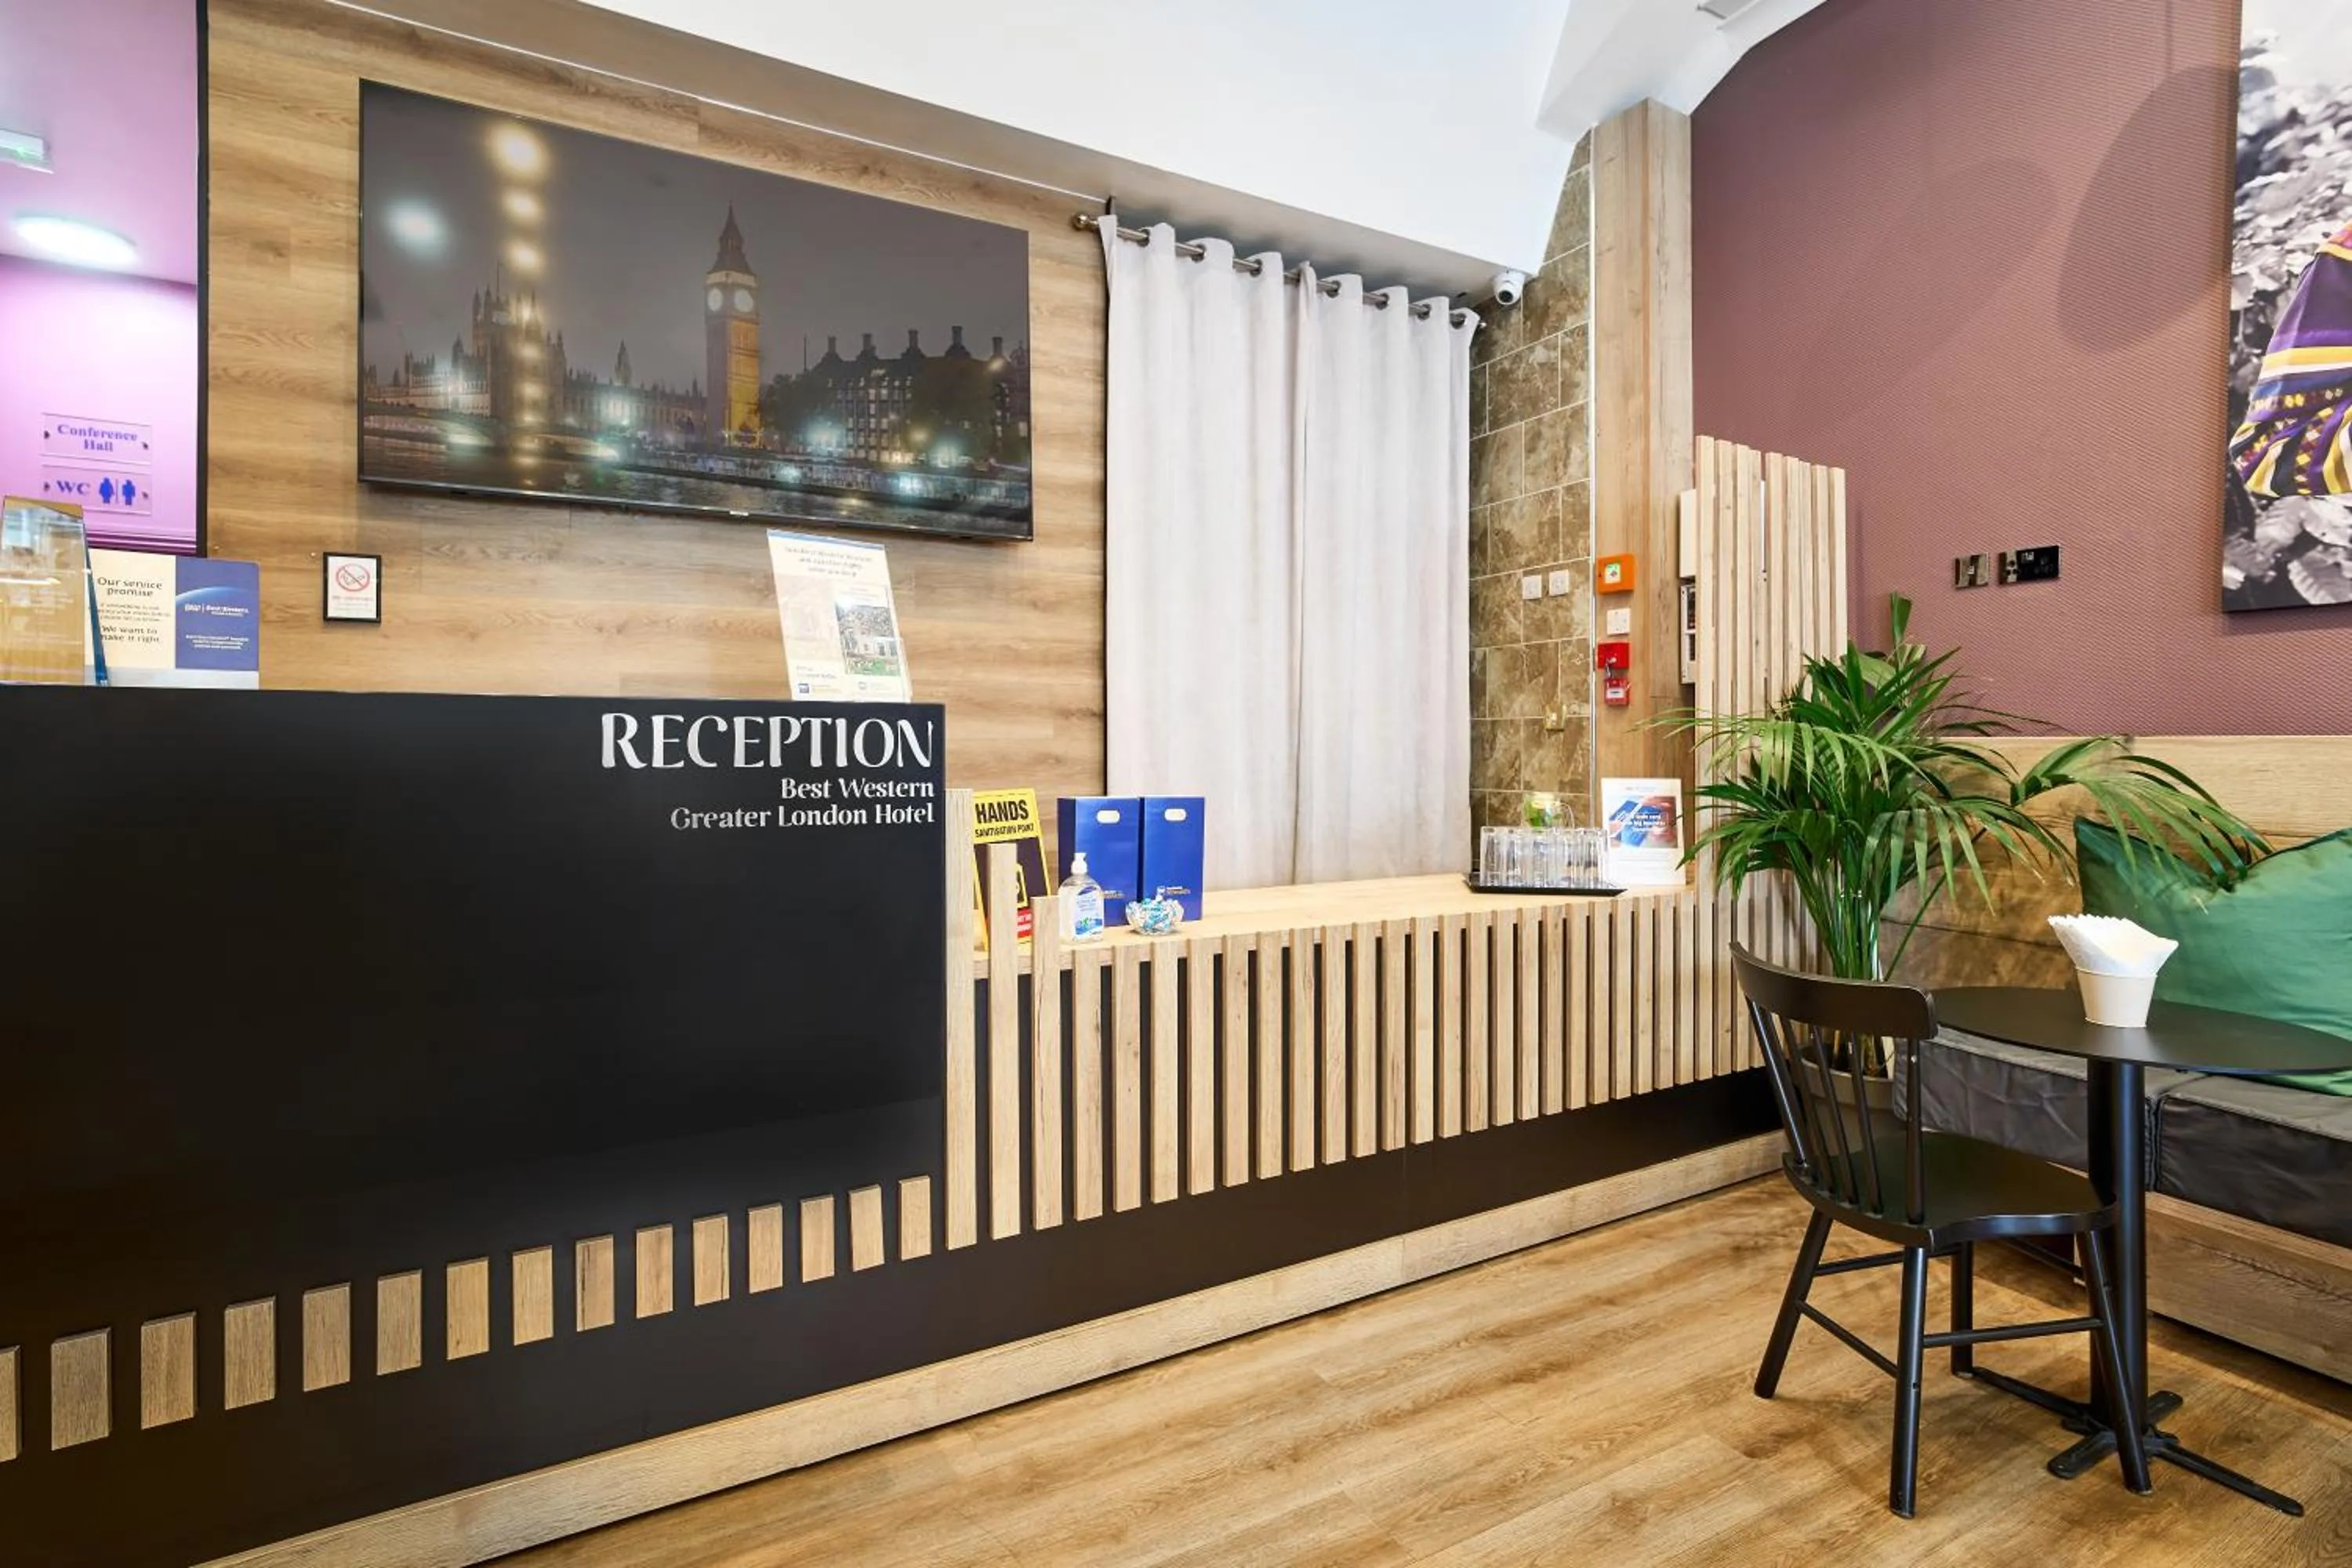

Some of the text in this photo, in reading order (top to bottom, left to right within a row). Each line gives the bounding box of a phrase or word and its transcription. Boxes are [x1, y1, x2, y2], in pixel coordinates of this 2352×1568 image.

[57, 423, 137, 441] Conference
[83, 439, 114, 452] Hall
[56, 480, 91, 495] WC
[97, 577, 162, 590] Our service
[106, 587, 154, 597] promise
[601, 712, 935, 770] RECEPTION
[780, 777, 935, 799] Best Western
[670, 802, 935, 830] Greater London Hotel
[975, 799, 1029, 825] HANDS
